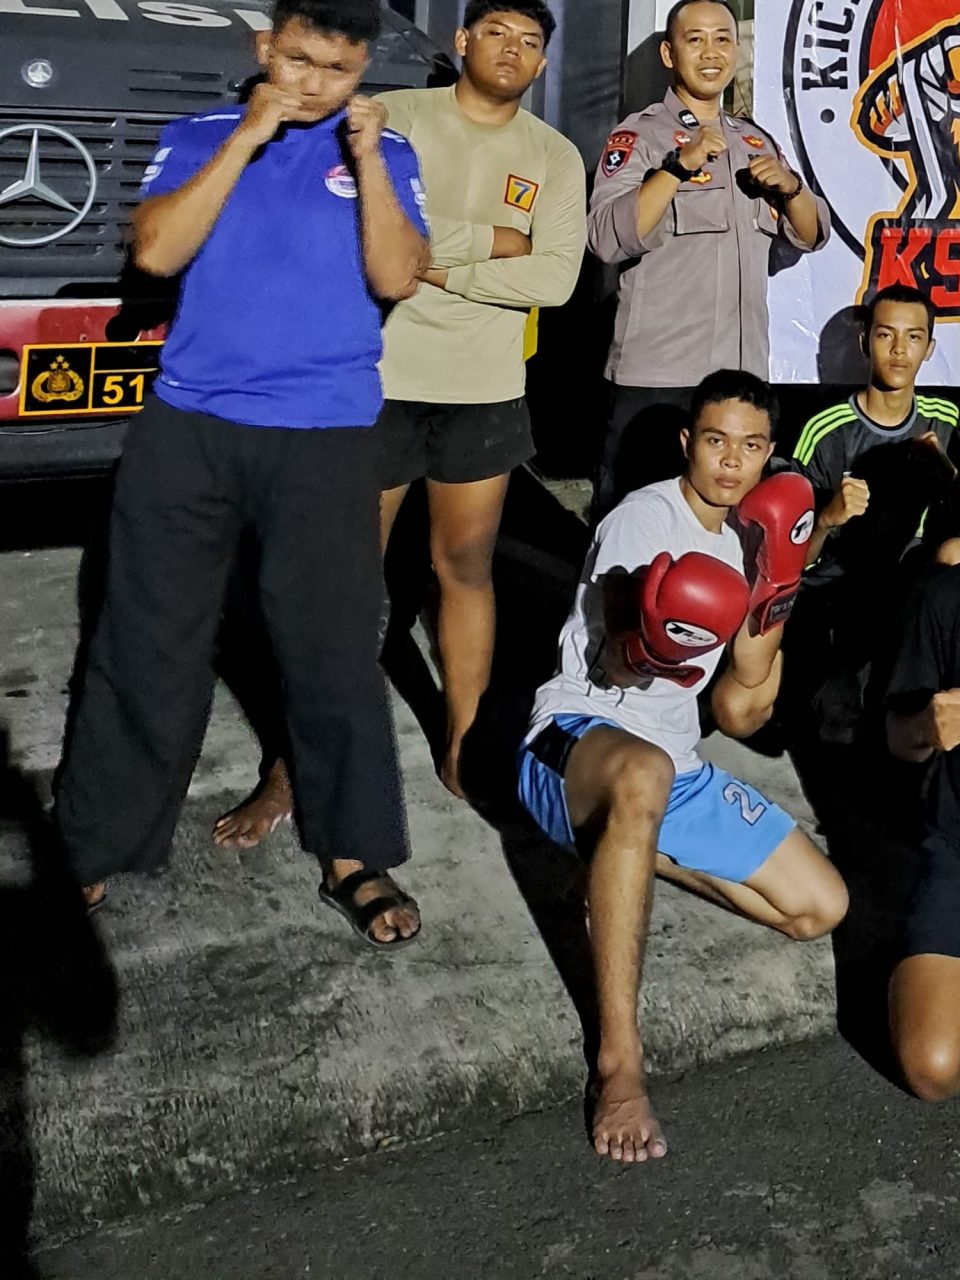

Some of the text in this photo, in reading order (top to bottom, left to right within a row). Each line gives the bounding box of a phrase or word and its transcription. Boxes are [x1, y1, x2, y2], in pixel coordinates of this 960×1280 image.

[514, 180, 532, 204] 7
[102, 374, 145, 405] 51
[722, 782, 768, 827] 2
